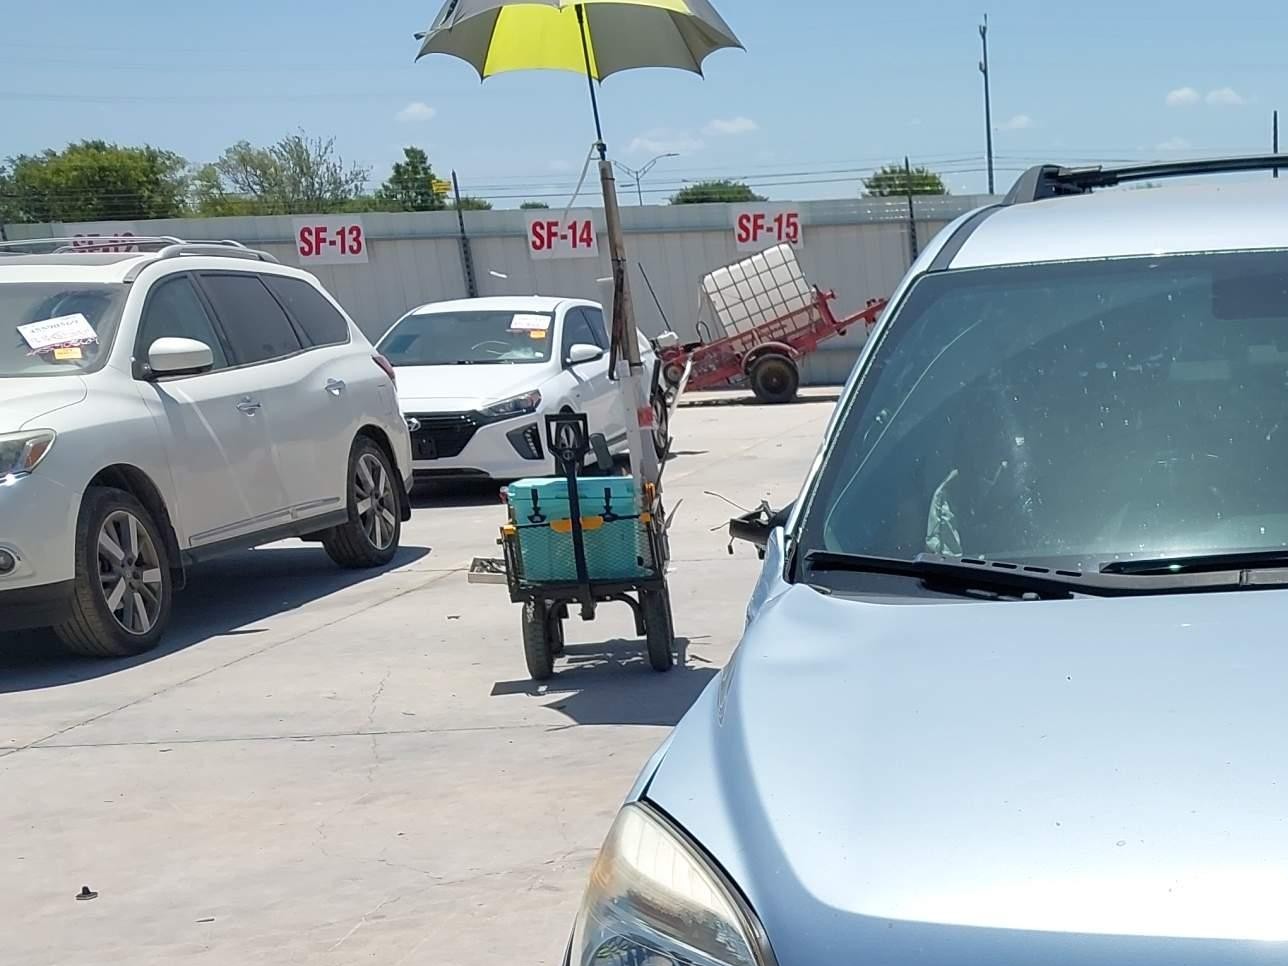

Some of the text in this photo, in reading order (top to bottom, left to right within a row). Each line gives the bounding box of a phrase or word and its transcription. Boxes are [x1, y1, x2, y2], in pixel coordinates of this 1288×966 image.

[299, 225, 362, 256] SF-13
[531, 220, 593, 250] SF-14
[737, 213, 799, 243] SF-15
